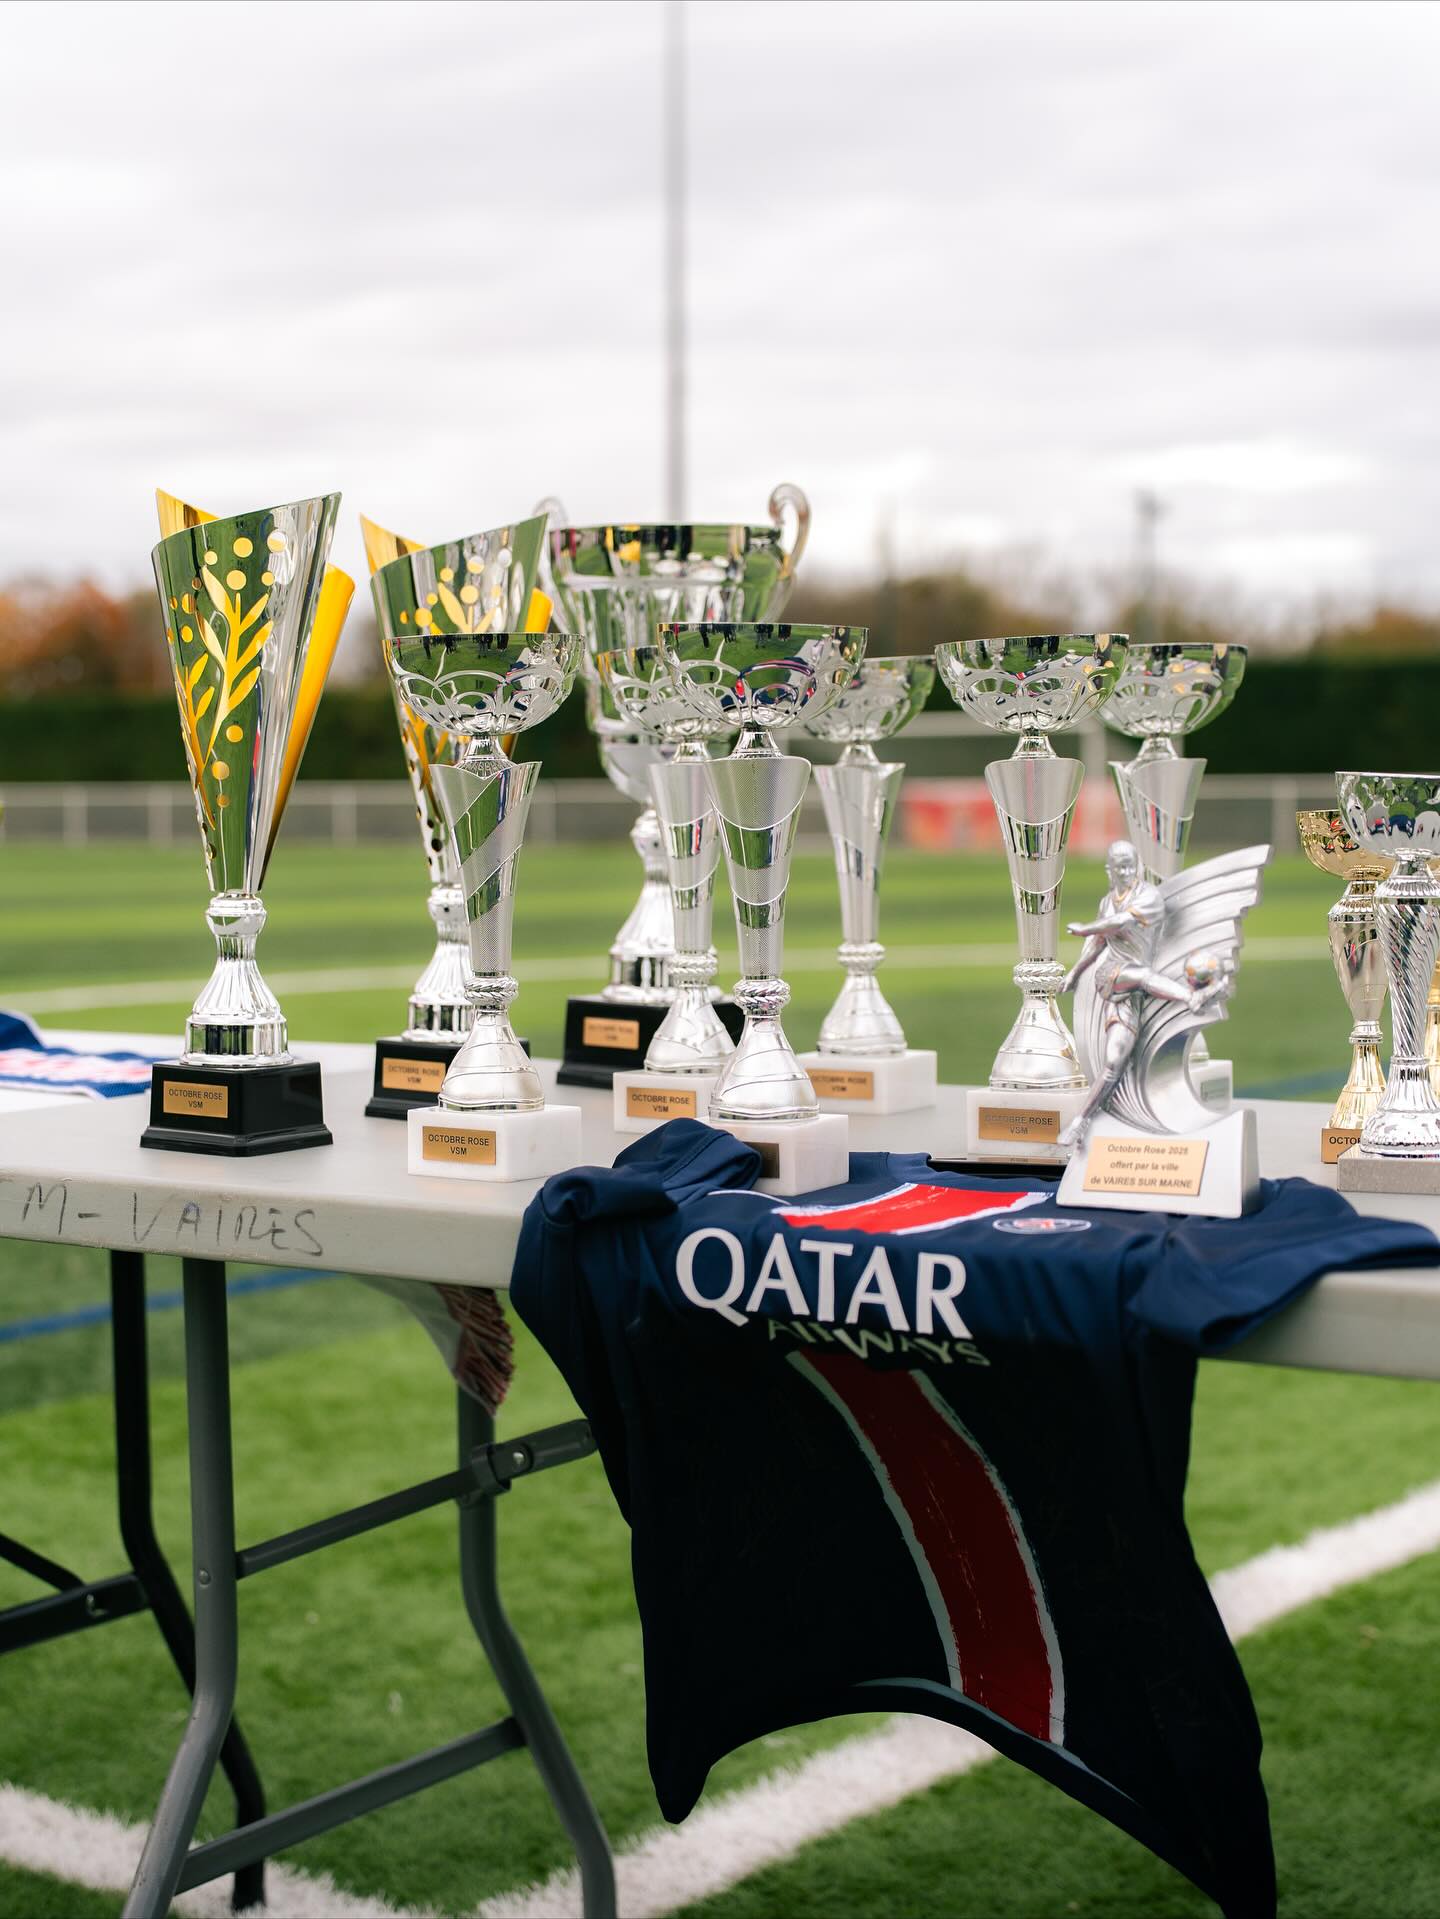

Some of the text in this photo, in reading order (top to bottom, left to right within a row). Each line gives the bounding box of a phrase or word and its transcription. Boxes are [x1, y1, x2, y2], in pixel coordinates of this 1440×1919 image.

[168, 1088, 224, 1101] OCTOBRE ROSE
[631, 1094, 690, 1105] OCTOBRE ROSE
[188, 1101, 203, 1109] VSM
[653, 1105, 669, 1113] VSM
[1029, 1116, 1053, 1126] ROSE
[1010, 1126, 1029, 1135] VSM
[428, 1134, 489, 1147] OCTOBRE ROSE
[450, 1146, 467, 1155] VSM
[1107, 1144, 1142, 1153] Octobre
[1143, 1145, 1166, 1155] Rose
[1110, 1160, 1179, 1171] offert par la ville
[1090, 1175, 1193, 1189] de VAIRES SUR MARNE
[675, 1227, 973, 1339] QATAR
